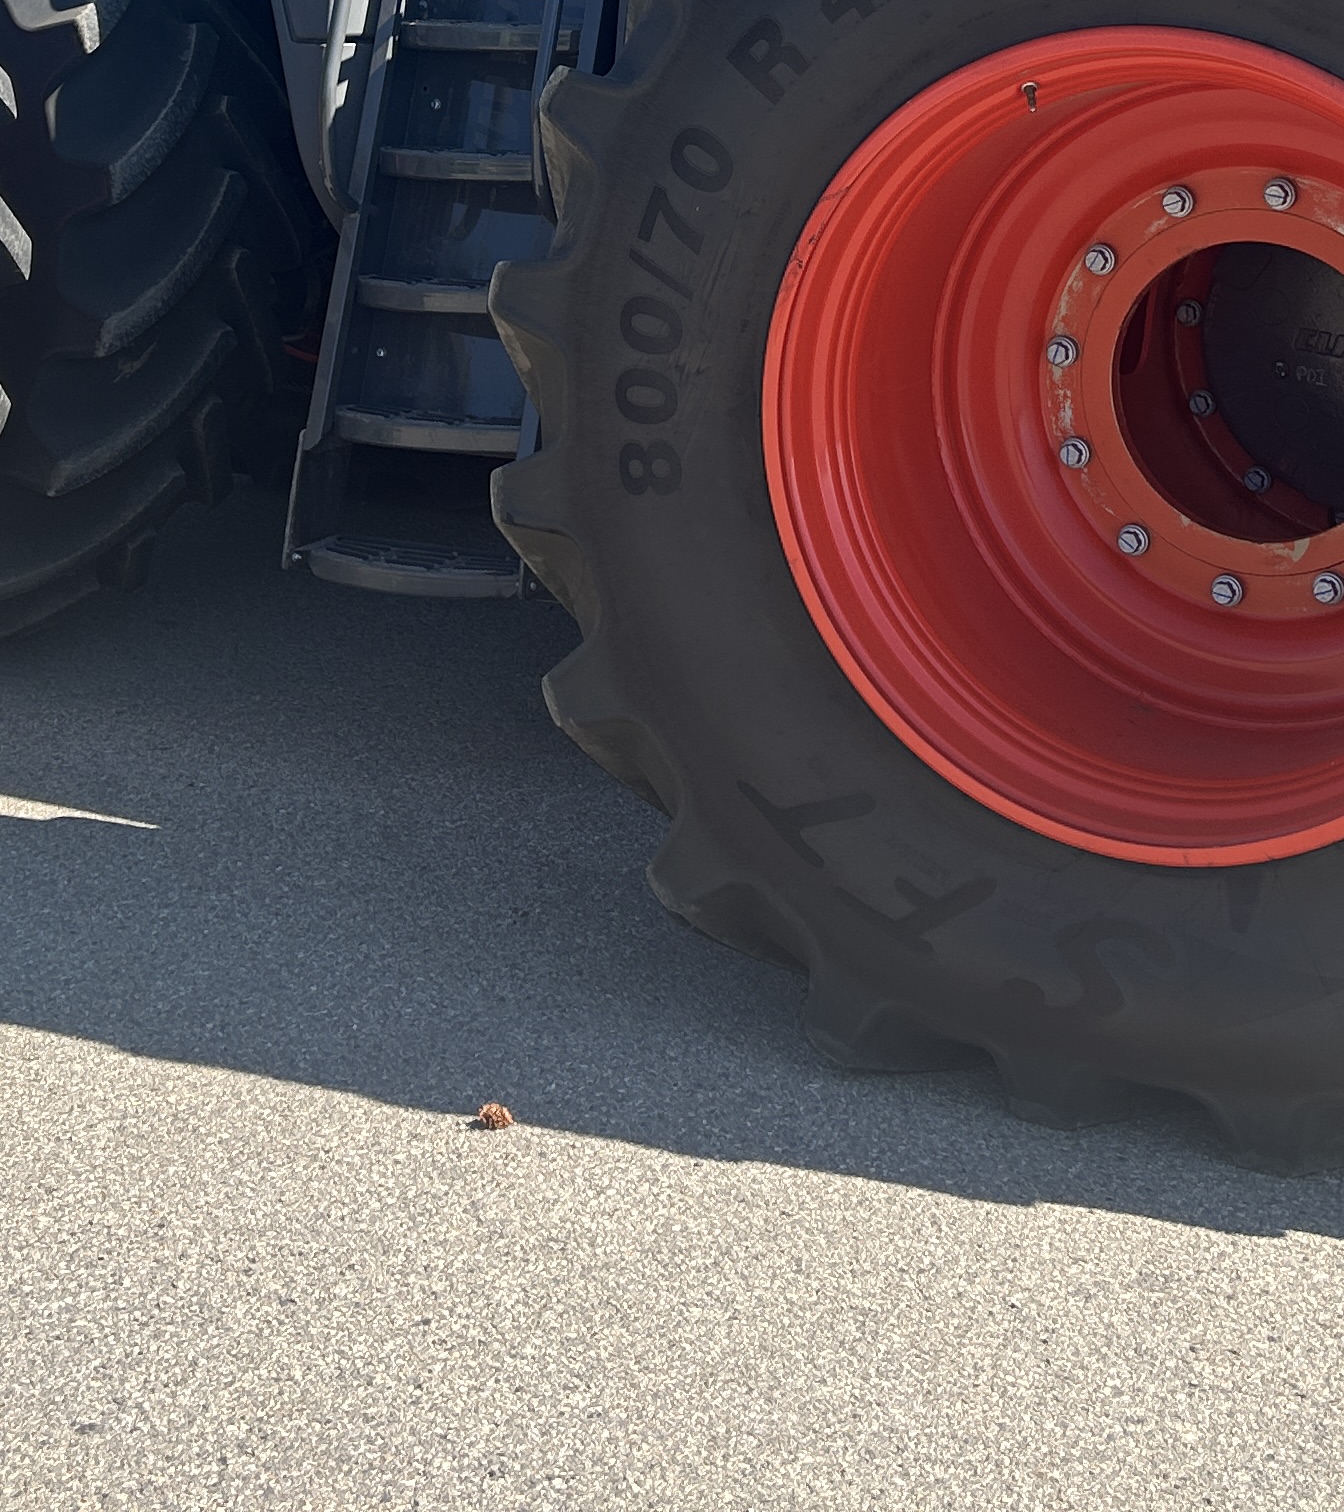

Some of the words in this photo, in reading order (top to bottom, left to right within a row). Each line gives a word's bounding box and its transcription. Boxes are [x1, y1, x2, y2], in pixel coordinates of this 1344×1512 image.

[615, 126, 738, 499] 800/70
[726, 16, 808, 106] R
[736, 778, 1177, 1020] SFT
